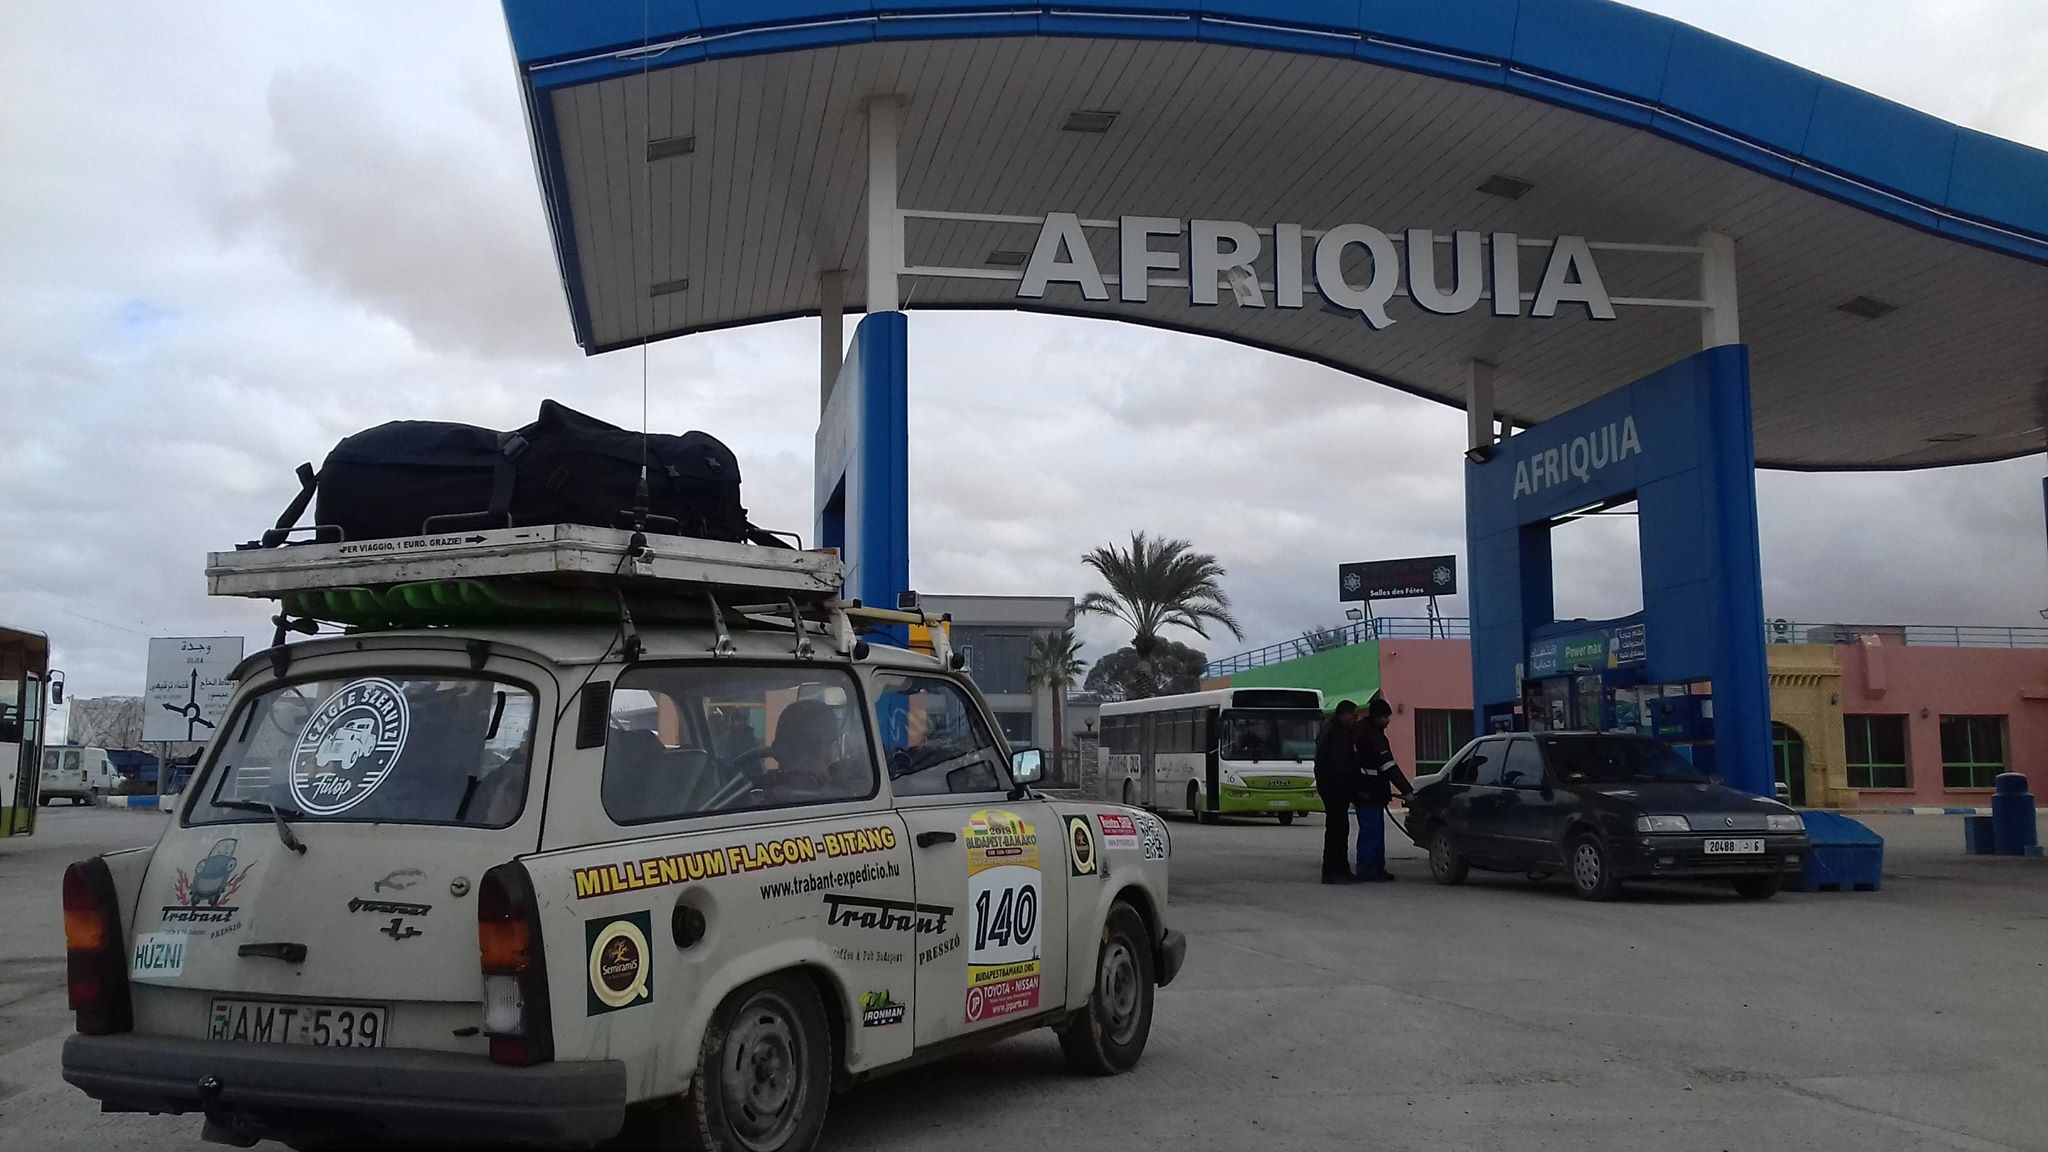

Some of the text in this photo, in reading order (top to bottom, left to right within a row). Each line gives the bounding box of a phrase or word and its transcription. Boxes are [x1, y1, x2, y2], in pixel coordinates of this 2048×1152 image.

[1016, 211, 1617, 330] AFRIQUIA
[1513, 414, 1643, 501] AFRIQUIA
[360, 542, 395, 553] VIAGGIO,
[181, 641, 211, 654] وجدة
[308, 688, 399, 742] CZIGLE SZERVIZ
[312, 772, 352, 801] Fülöp
[989, 828, 1012, 836] 2018
[1710, 841, 1735, 852] 20488
[1754, 841, 1760, 852] 6
[576, 852, 725, 898] MILLENIUM
[728, 835, 813, 872] FLACON
[825, 826, 896, 857] BITANG
[760, 860, 900, 900] www.trabant-expedicio.hu
[161, 906, 240, 923] Trabant
[823, 893, 954, 935] Trabant
[974, 884, 1038, 951] 140
[134, 937, 183, 969] HÚZNI
[918, 932, 961, 967] PRESSZÓ
[983, 982, 1011, 998] TOYOTA
[1015, 977, 1040, 992] NISSAN
[864, 1007, 903, 1021] IRONMAN
